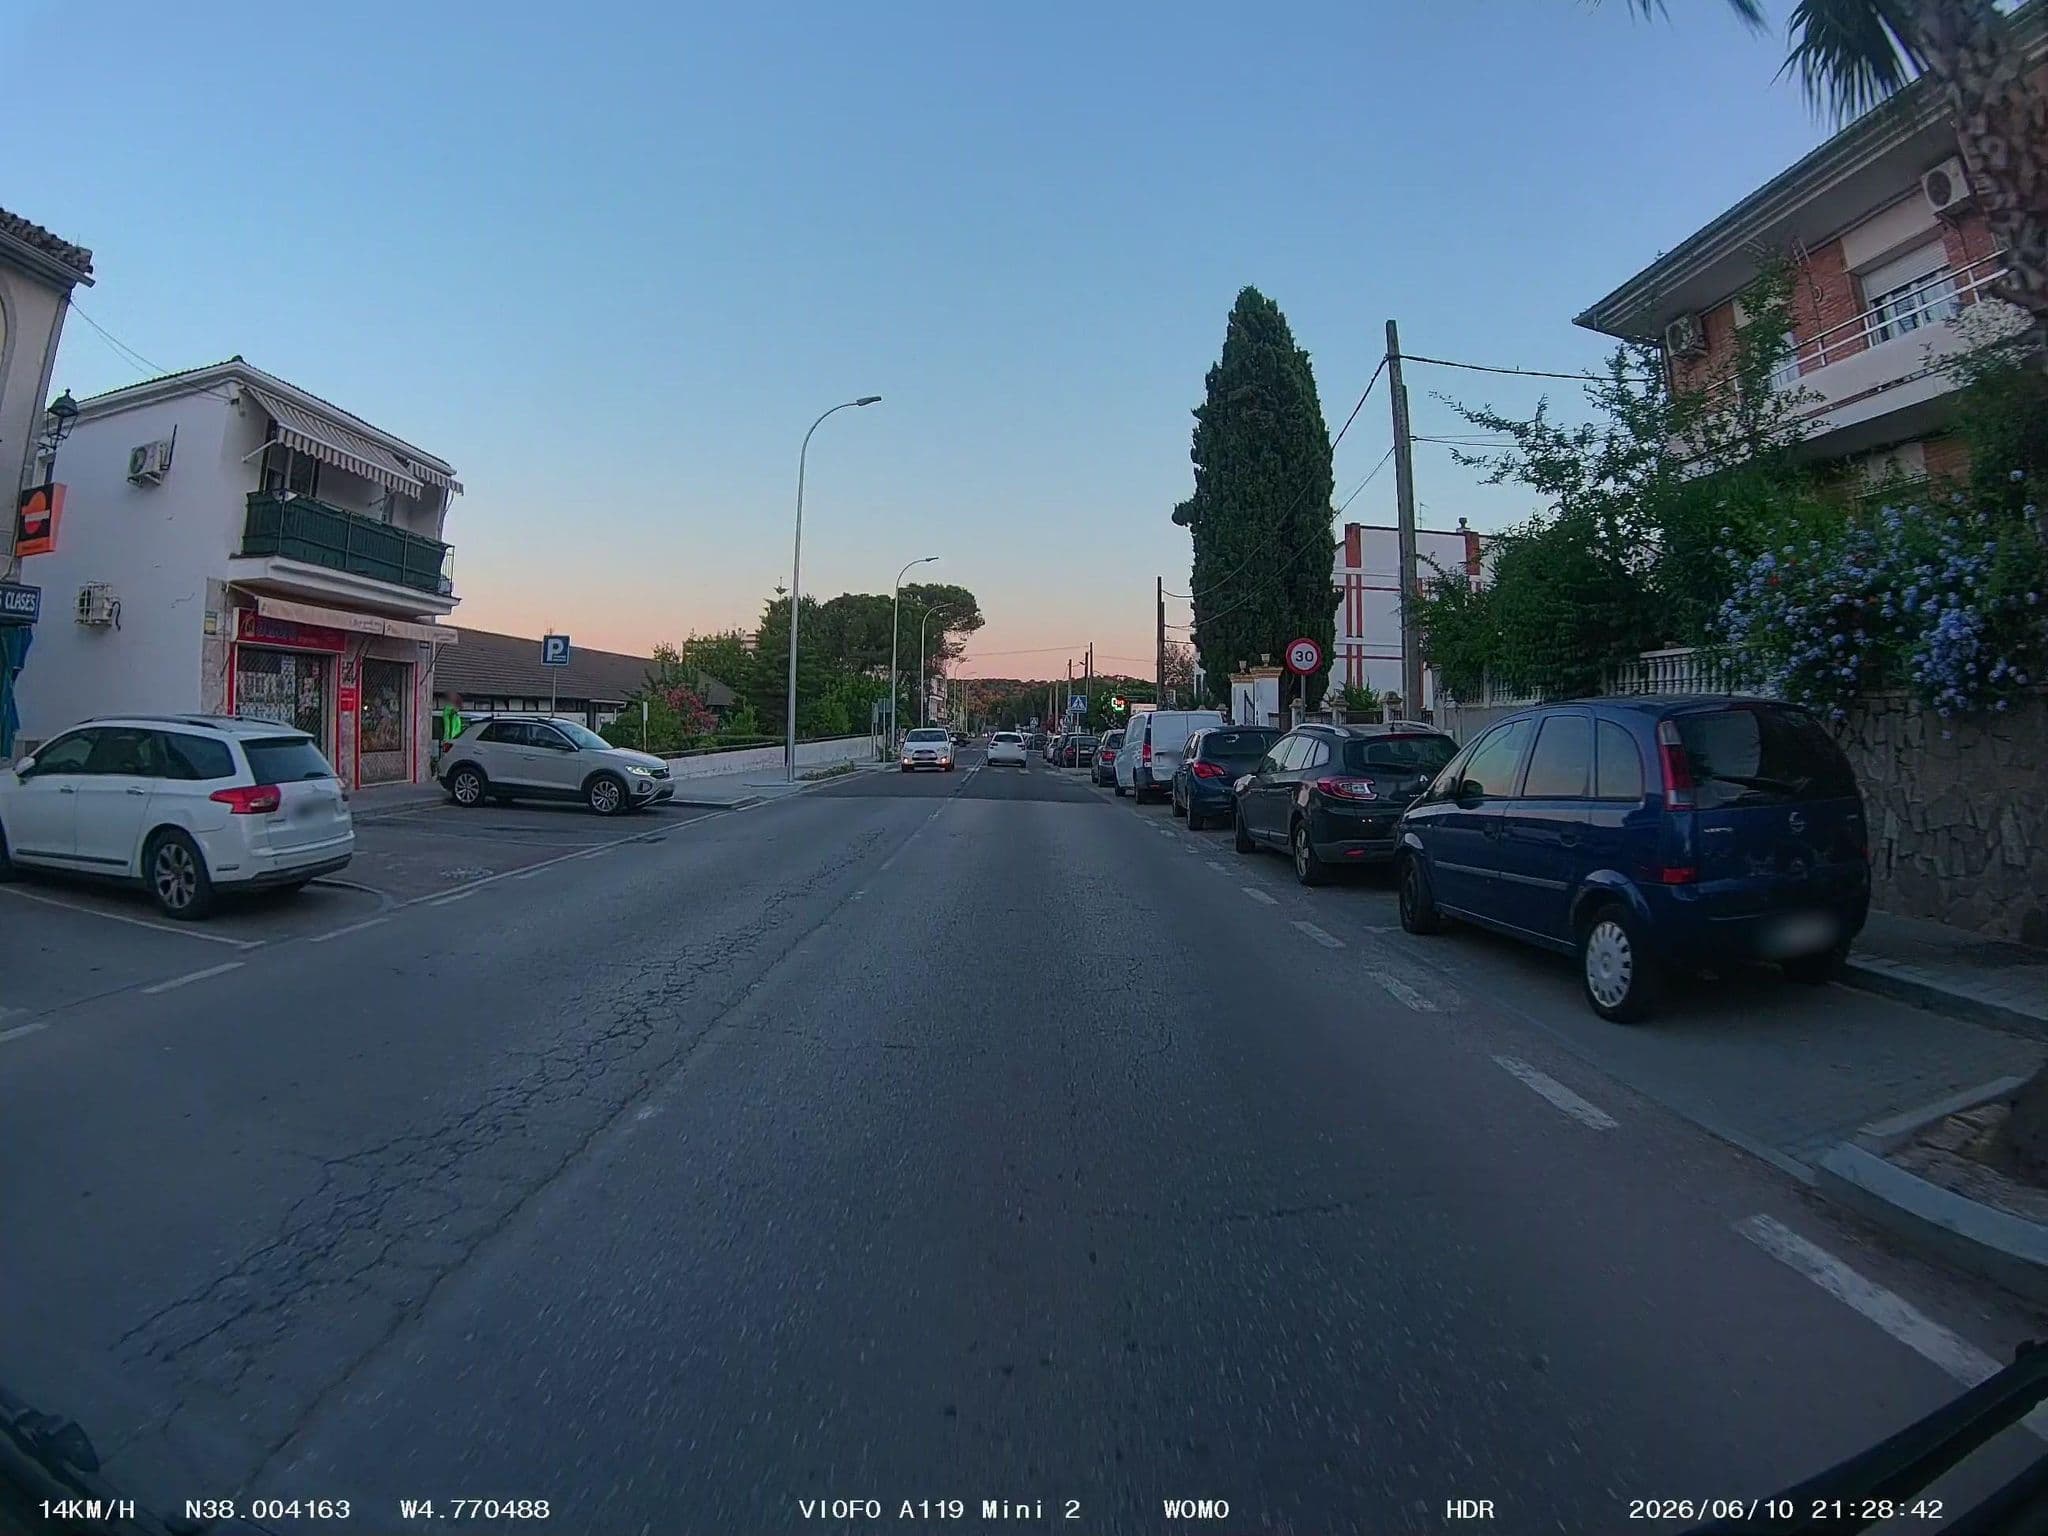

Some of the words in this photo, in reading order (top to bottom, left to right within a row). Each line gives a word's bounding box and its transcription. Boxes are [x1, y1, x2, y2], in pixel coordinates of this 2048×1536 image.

[5, 591, 36, 611] CLASES
[546, 638, 564, 662] P
[1295, 650, 1314, 662] 30
